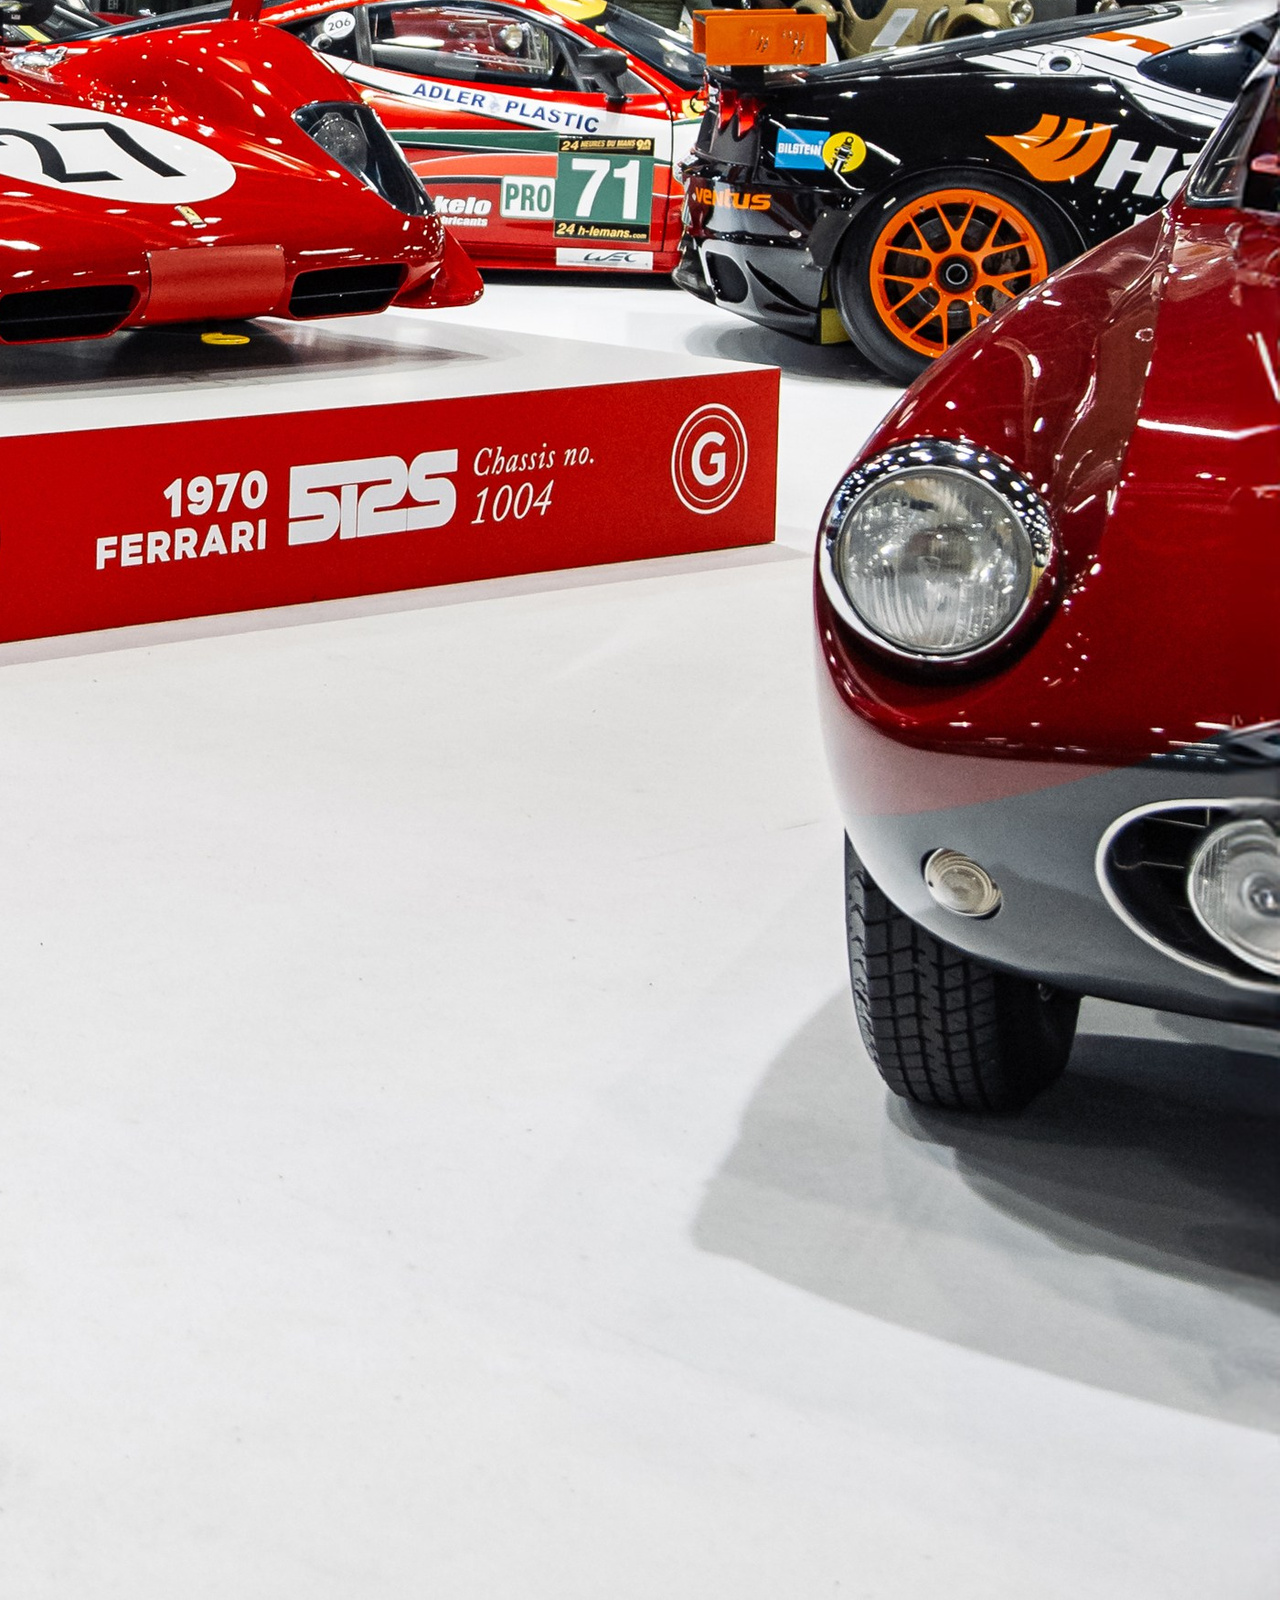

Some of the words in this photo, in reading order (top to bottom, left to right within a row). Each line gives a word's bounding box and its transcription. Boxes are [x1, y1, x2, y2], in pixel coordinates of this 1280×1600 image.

[327, 18, 352, 33] 206
[412, 82, 486, 108] ADLER
[505, 100, 600, 133] PLASTIC
[561, 140, 579, 151] 24
[580, 140, 606, 148] HEURES
[606, 140, 617, 148] DU
[617, 139, 636, 148] MANS
[778, 141, 822, 157] BILSTEIN
[505, 183, 551, 213] PRO
[571, 157, 641, 220] 71
[695, 186, 772, 211] ventus
[556, 222, 576, 235] 24
[577, 225, 648, 240] h-lemans.com
[472, 441, 557, 477] Chassis
[562, 445, 596, 469] no.
[690, 430, 727, 487] G
[163, 469, 269, 519] 1970
[470, 479, 556, 526] 1004
[95, 518, 268, 571] FERRARI
